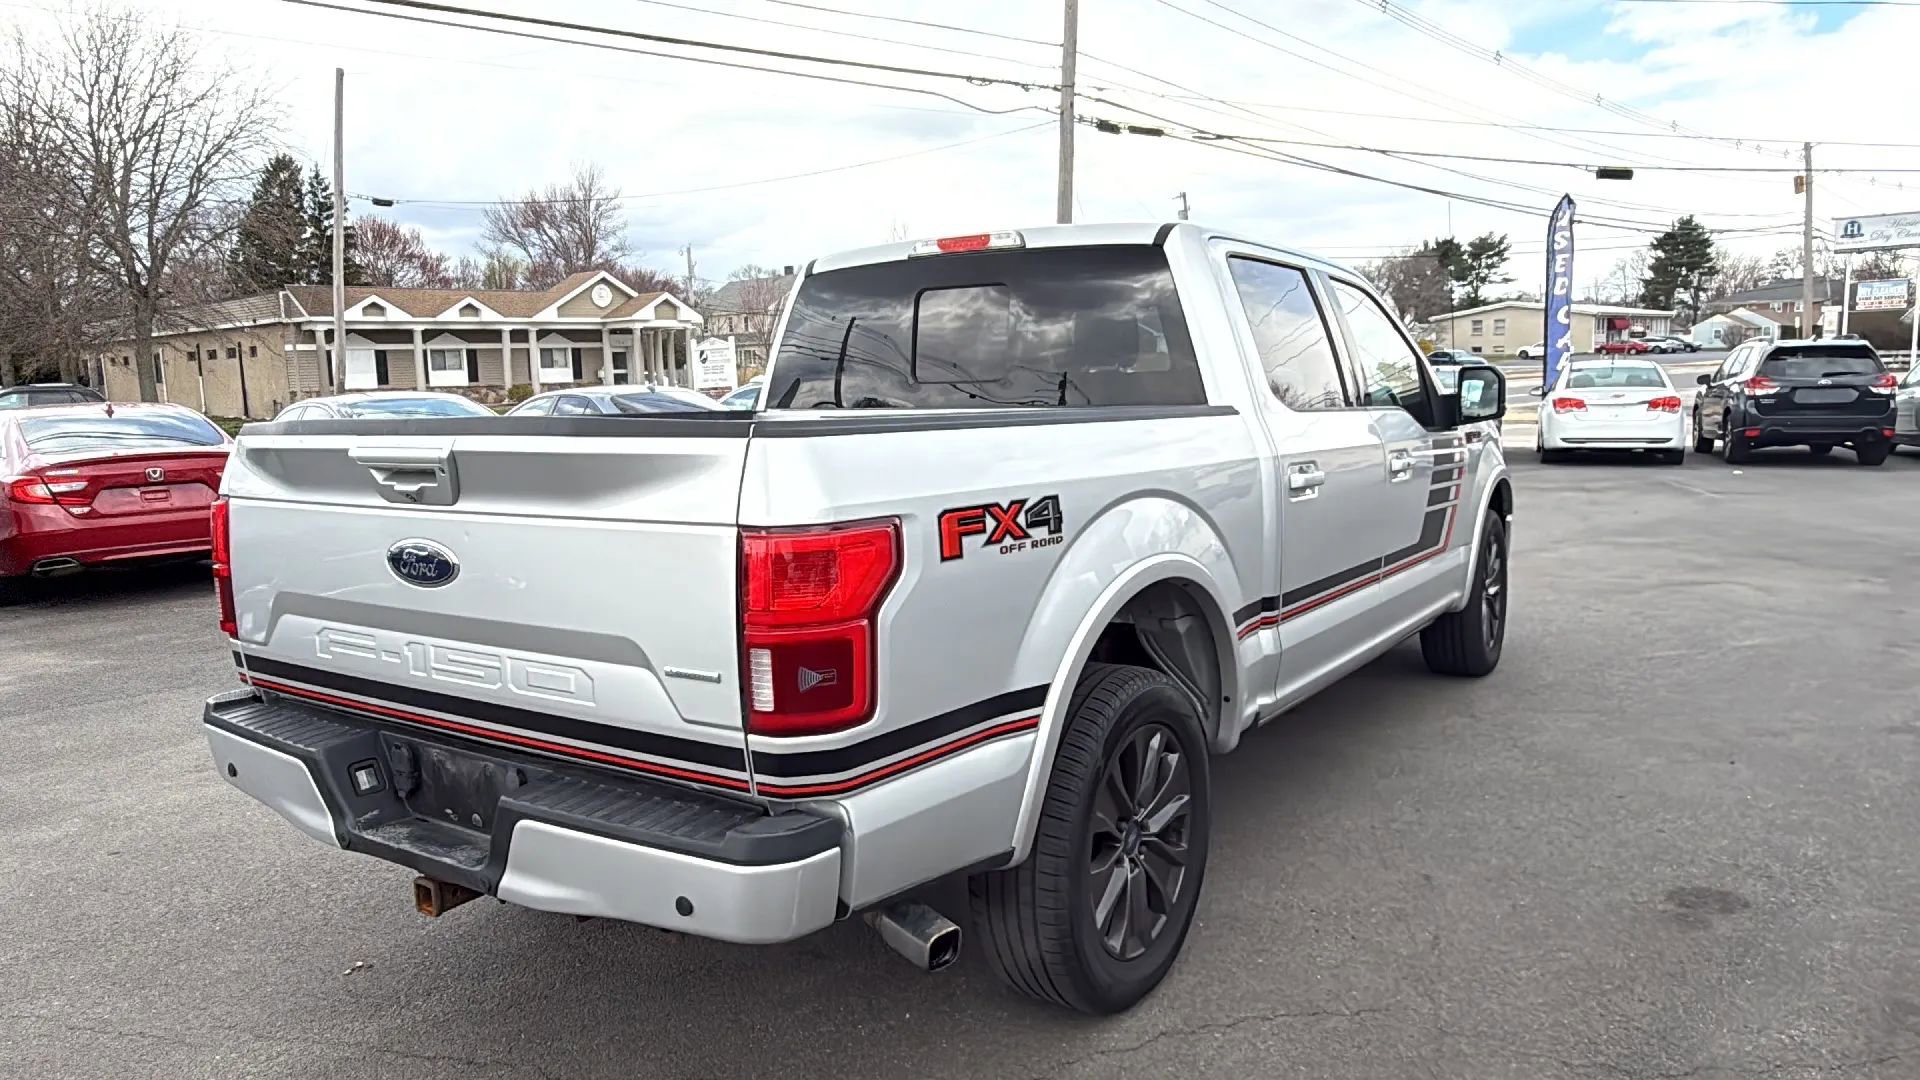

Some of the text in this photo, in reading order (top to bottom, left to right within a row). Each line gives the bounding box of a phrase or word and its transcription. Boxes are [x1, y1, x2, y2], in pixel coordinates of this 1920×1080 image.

[937, 494, 1063, 563] FX4
[1000, 535, 1063, 555] OFF ROAD
[400, 548, 438, 578] Ford
[315, 626, 597, 707] F-150
